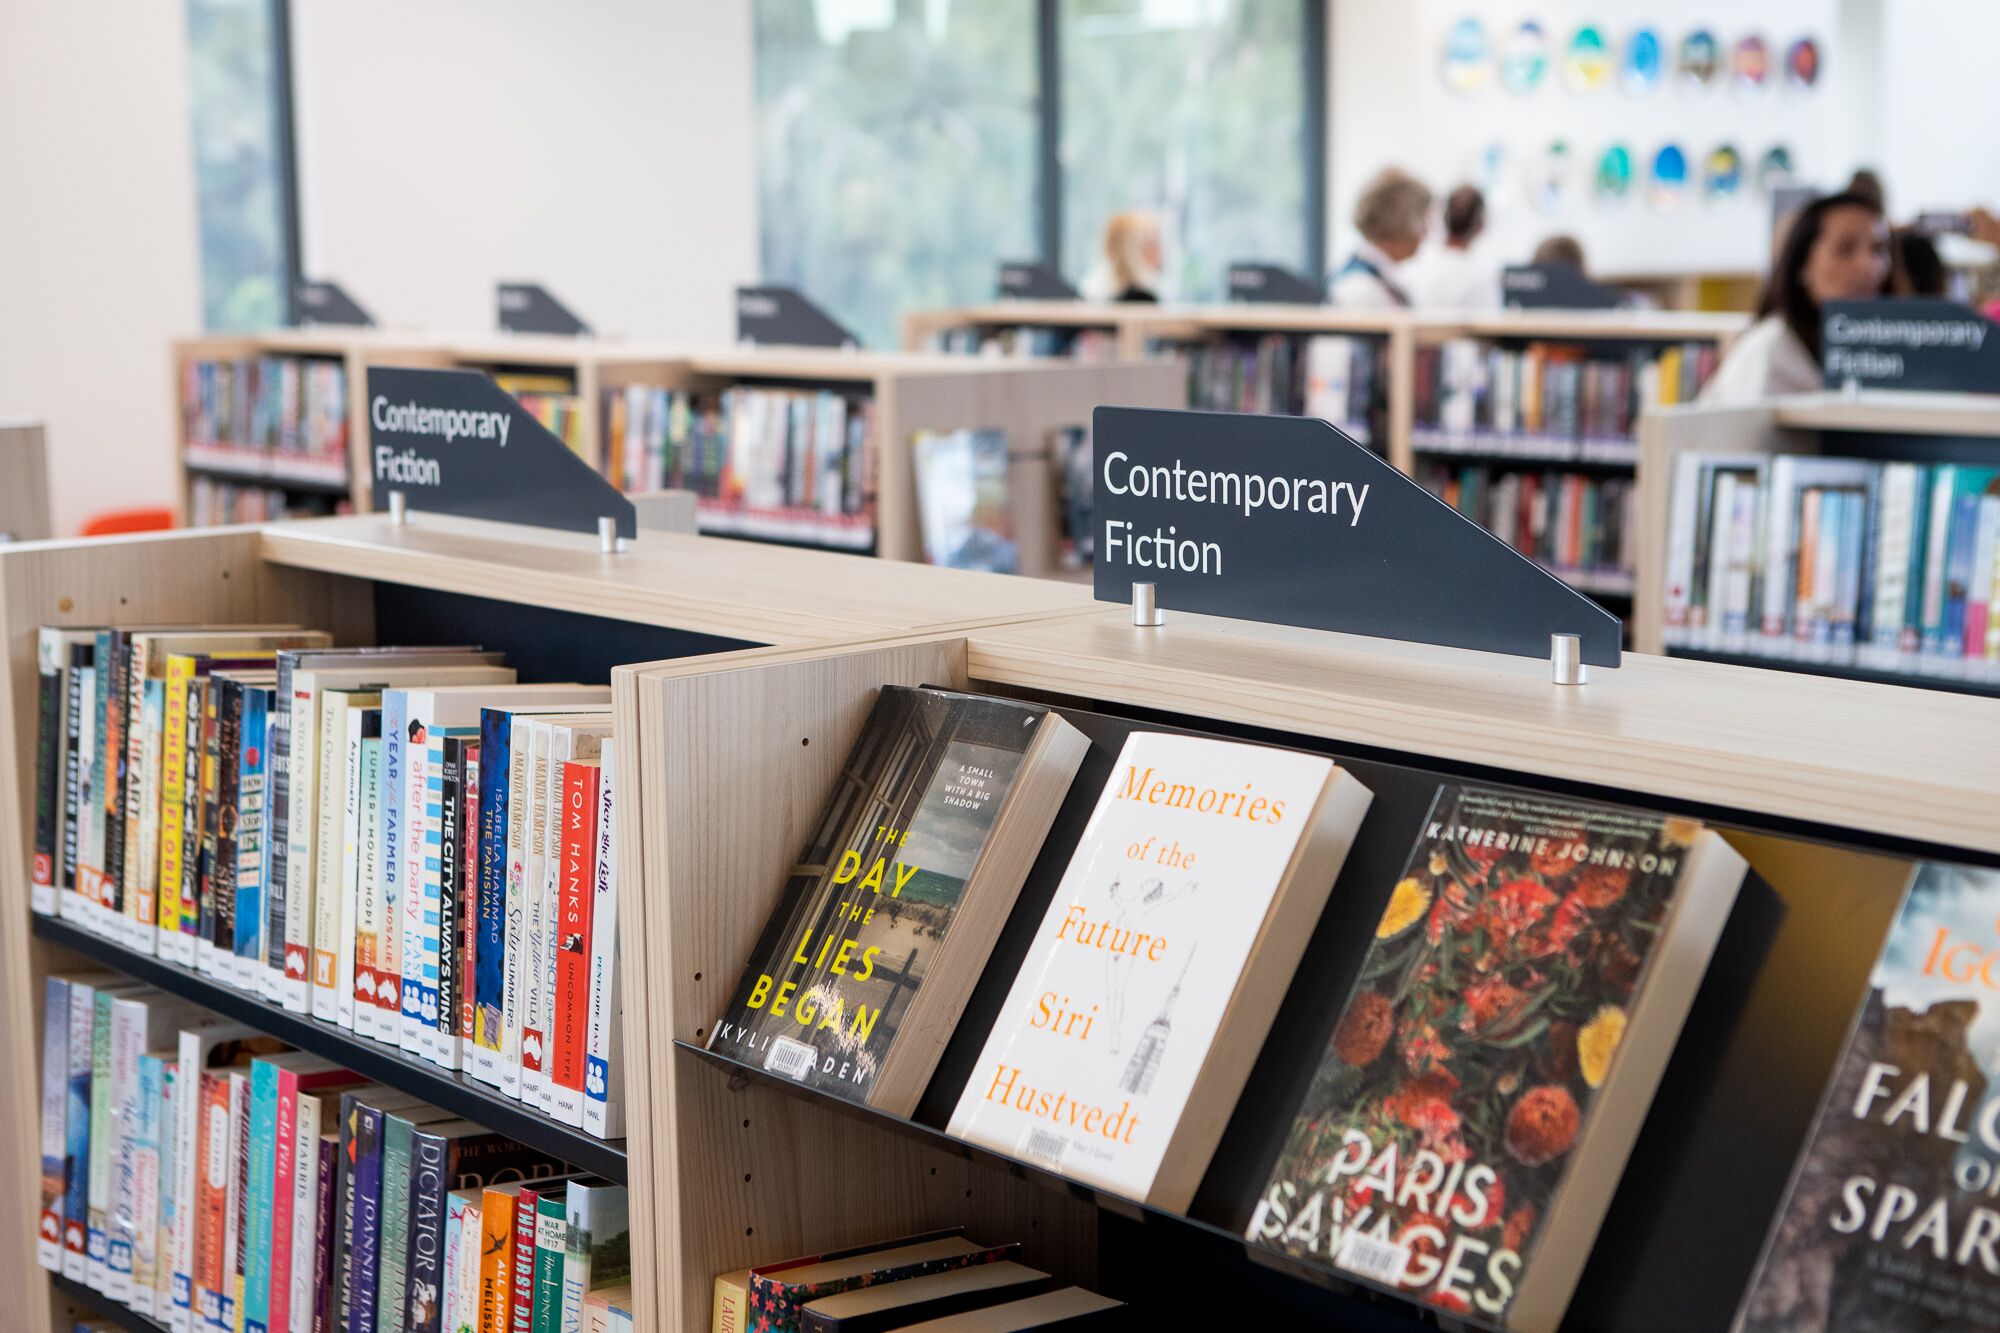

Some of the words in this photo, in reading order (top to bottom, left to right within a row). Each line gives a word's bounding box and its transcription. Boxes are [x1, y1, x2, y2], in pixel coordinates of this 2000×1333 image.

[1825, 313, 1988, 350] Contemporary
[1825, 346, 1904, 379] Fiction
[373, 395, 511, 447] Contemporary
[375, 445, 440, 486] Fiction
[1103, 452, 1370, 527] Contemporary
[1105, 520, 1223, 576] Fiction
[130, 643, 144, 728] GRAVEL
[168, 666, 182, 785] STEPHEN
[296, 722, 306, 771] STOLEN
[326, 707, 336, 737] THE
[128, 738, 144, 817] HEART
[323, 740, 335, 809] OPTICKAL
[347, 740, 358, 816] Asymmetry
[368, 749, 378, 811] SUMMER
[389, 729, 399, 779] YEAR
[512, 750, 524, 794] AMANDA
[535, 755, 546, 801] AMANDA
[959, 764, 965, 773] A
[966, 766, 993, 778] SMALL
[294, 777, 305, 834] SEASON
[412, 761, 427, 811] after
[552, 759, 563, 804] AMANDA
[572, 779, 583, 830] TOM
[602, 779, 613, 828] After
[943, 795, 981, 810] SHADOW
[944, 784, 967, 796] WITH
[967, 789, 973, 797] A
[975, 790, 990, 801] BIG
[959, 775, 985, 788] TOWN
[1117, 765, 1287, 826] Memories
[411, 819, 425, 854] the
[444, 796, 455, 840] THE
[485, 809, 494, 840] THE
[493, 788, 503, 863] ISABELLA
[511, 797, 523, 850] HAMPSON
[533, 803, 546, 857] HAMPSON
[551, 807, 562, 860] HAMPSON
[875, 826, 911, 847] THE
[164, 807, 177, 919] FLORIDA
[320, 814, 332, 884] ILLUSION
[365, 828, 376, 882] MOUNT
[386, 807, 397, 884] FARMER
[442, 841, 454, 893] CITY
[1126, 838, 1156, 863] of
[1157, 841, 1196, 871] the
[1426, 821, 1550, 856] KATHERINE
[1557, 842, 1678, 877] JOHNSON
[291, 864, 302, 925] RODNEY
[406, 861, 422, 921] party
[467, 882, 474, 898] GO
[483, 845, 493, 919] PARISIAN
[567, 843, 582, 925] HANKS
[832, 850, 920, 899] DAY
[364, 886, 373, 926] HOPE
[490, 869, 500, 944] HAMMAD
[504, 901, 524, 953] Sixty
[531, 900, 541, 927] THE
[550, 902, 559, 919] The
[838, 902, 875, 926] THE
[385, 904, 394, 965] ROSALIE
[440, 893, 453, 978] ALWAYS
[529, 928, 544, 984] Yellow
[547, 919, 559, 996] FRENCH
[793, 929, 881, 983] LIES
[1056, 906, 1168, 962] Future
[439, 980, 451, 1036] WINS
[506, 953, 517, 1029] SUMMERS
[529, 987, 539, 1027] VILLA
[565, 962, 575, 1044] UNCOMMON
[594, 955, 603, 1018] PENELOPE
[747, 974, 880, 1045] BEGAN
[1030, 991, 1100, 1041] Siri
[563, 1050, 572, 1080] TYPE
[720, 1022, 770, 1052] KYLI
[809, 1052, 867, 1085] ADEN
[522, 1083, 539, 1093] HAMP
[558, 1101, 574, 1111] HANK
[985, 1064, 1142, 1146] Hustvedt
[264, 1115, 272, 1126] A
[279, 1096, 291, 1138] Cold
[586, 1110, 600, 1120] HANL
[260, 1134, 273, 1204] Thousand
[298, 1135, 310, 1201] HARRIS
[386, 1150, 398, 1203] Peaches
[1327, 1128, 1498, 1228] PARIS
[258, 1207, 270, 1250] Roads
[385, 1208, 396, 1230] for
[395, 1162, 410, 1261] JOANNE
[415, 1142, 441, 1272] DICTATOR
[517, 1202, 534, 1238] THE
[544, 1219, 560, 1230] WAR
[360, 1194, 376, 1282] JOANNE
[537, 1227, 545, 1236] AT
[545, 1228, 566, 1242] HOME
[543, 1237, 559, 1249] 1917
[1255, 1180, 1523, 1313] SAVAGES
[352, 1245, 363, 1312] Chocolat
[383, 1236, 395, 1305] Monsieur
[496, 1259, 506, 1288] ALL
[515, 1243, 533, 1301] FIRST
[543, 1254, 556, 1273] The
[382, 1308, 392, 1321] le
